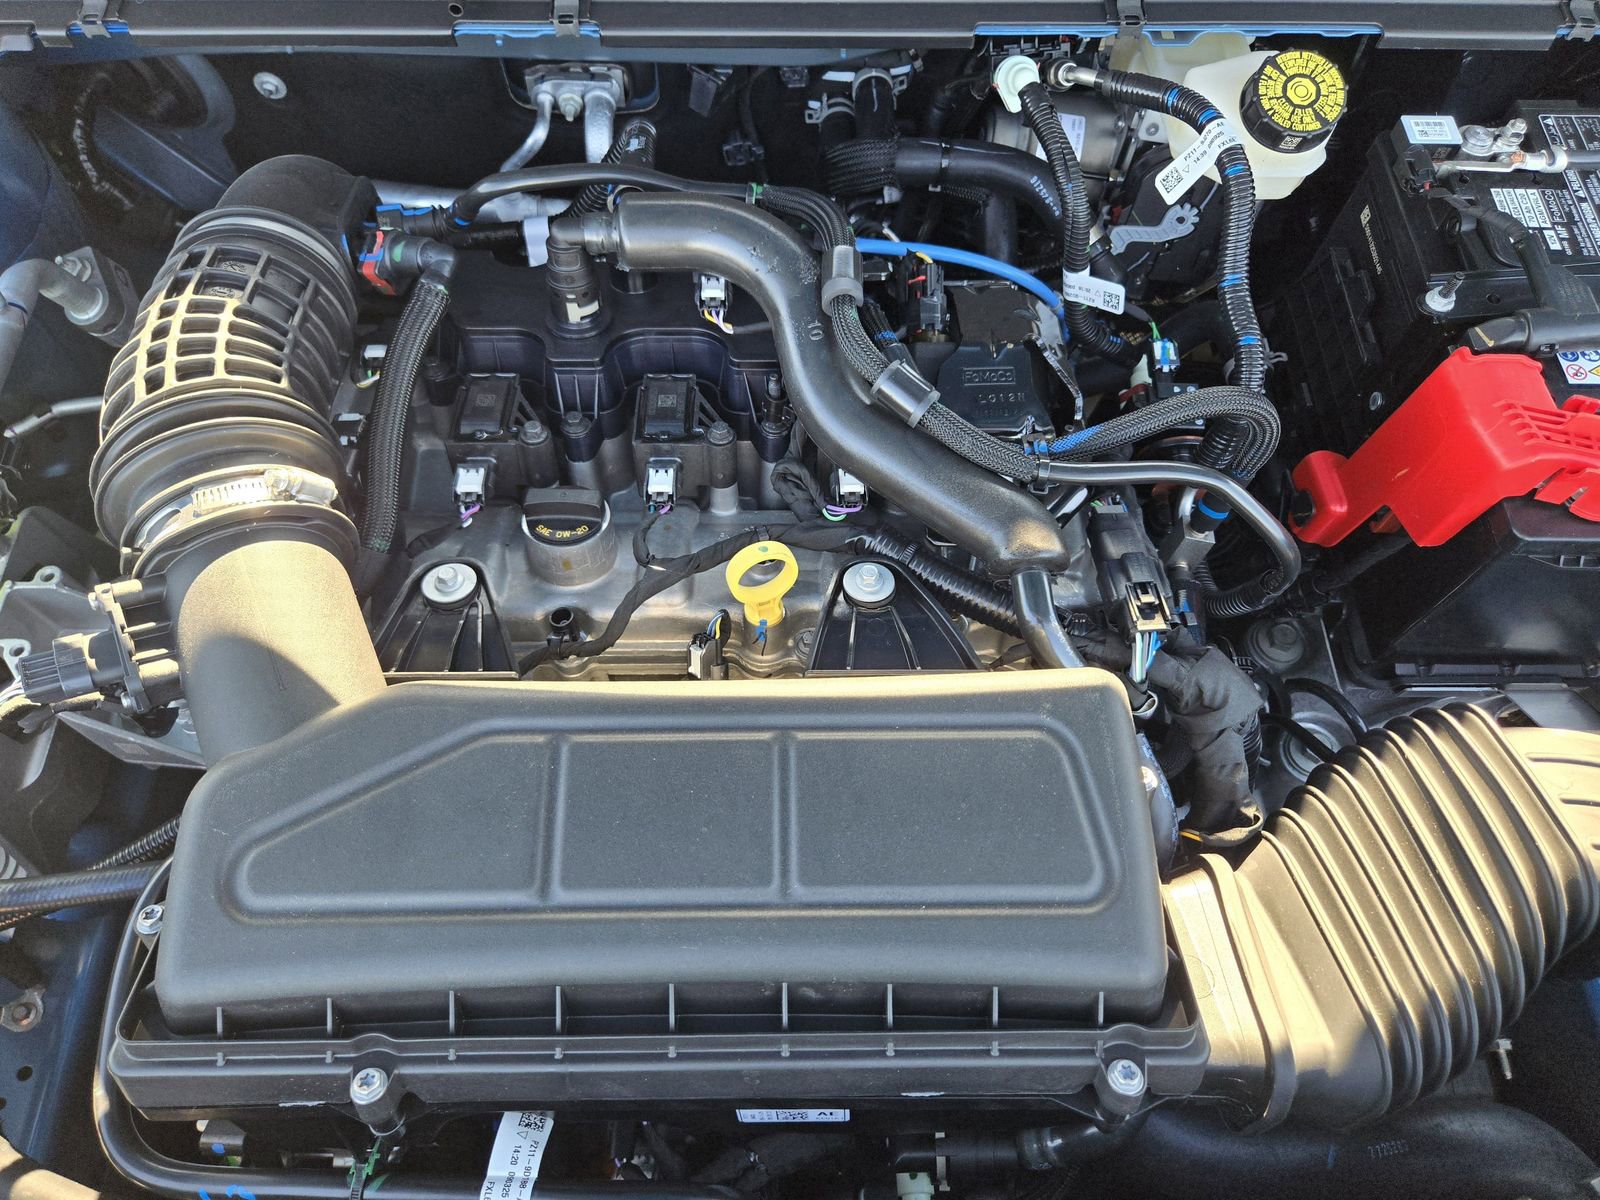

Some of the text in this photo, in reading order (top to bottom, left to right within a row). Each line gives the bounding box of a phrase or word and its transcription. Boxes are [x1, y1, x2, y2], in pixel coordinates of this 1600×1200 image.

[1277, 98, 1294, 113] CLEAN
[1294, 107, 1312, 116] FILLER
[1271, 113, 1291, 129] SEALED
[1292, 121, 1321, 131] CONTAINER
[1291, 114, 1301, 123] USE
[1302, 115, 1316, 123] ONLY
[1517, 193, 1528, 204] C20
[1545, 190, 1562, 221] FoMoCo
[1554, 224, 1569, 237] MF
[1546, 234, 1557, 244] 12V
[965, 370, 1013, 382] FoMoCo
[536, 524, 589, 538] SAE 0W-20
[510, 1144, 522, 1166] 14:20
